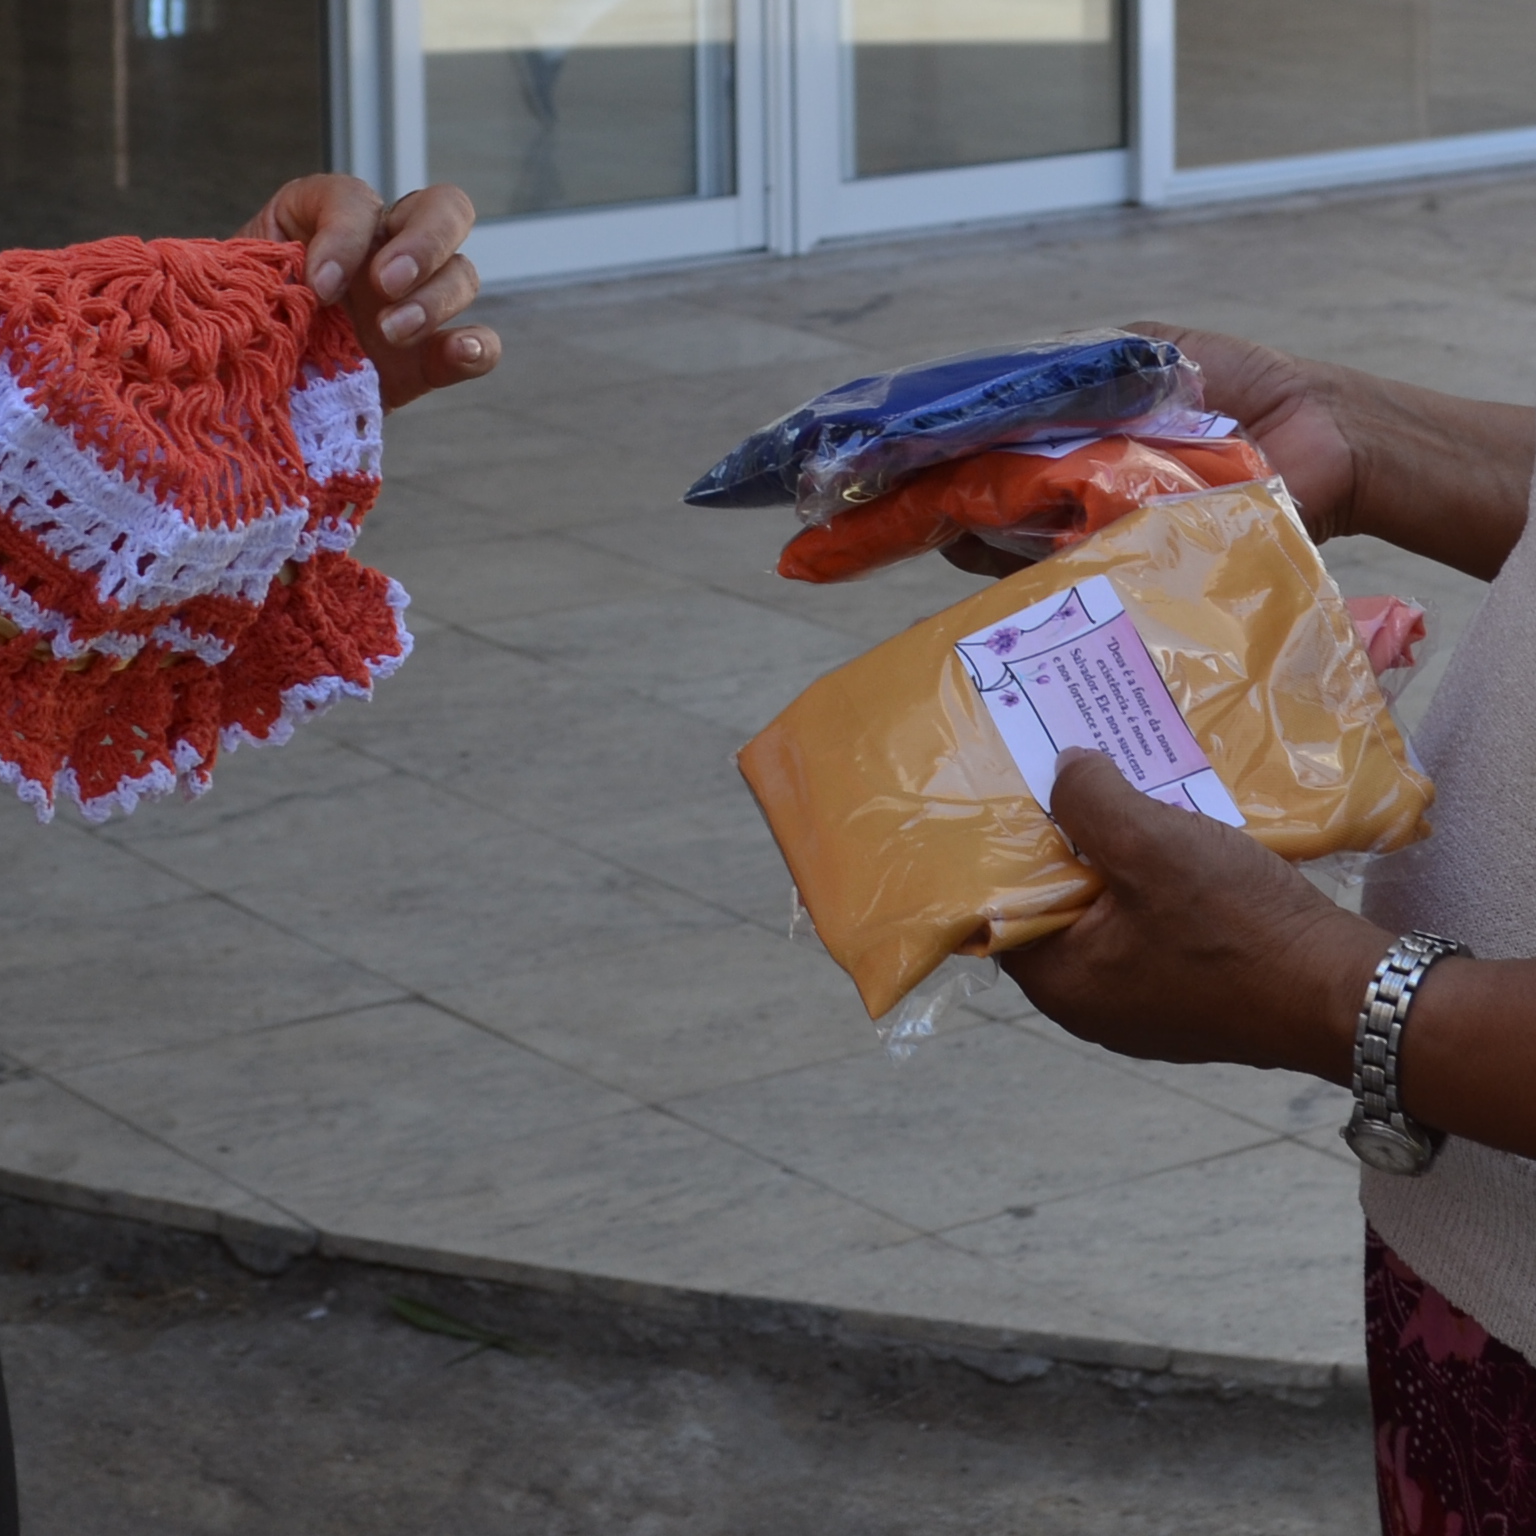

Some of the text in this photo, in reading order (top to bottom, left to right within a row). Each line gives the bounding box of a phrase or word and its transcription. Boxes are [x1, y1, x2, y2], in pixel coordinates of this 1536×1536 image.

[1057, 664, 1071, 682] nos
[1067, 683, 1097, 729] fortalece
[1093, 731, 1102, 739] a
[1069, 647, 1099, 694] Salvador.
[1095, 694, 1110, 713] Ele
[1106, 715, 1121, 735] nos
[1117, 737, 1145, 781] sustenta
[1096, 659, 1129, 714] existência,
[1131, 725, 1152, 756] nosso
[1132, 687, 1152, 717] fonte
[1149, 718, 1161, 732] da
[1156, 734, 1177, 763] nossa
